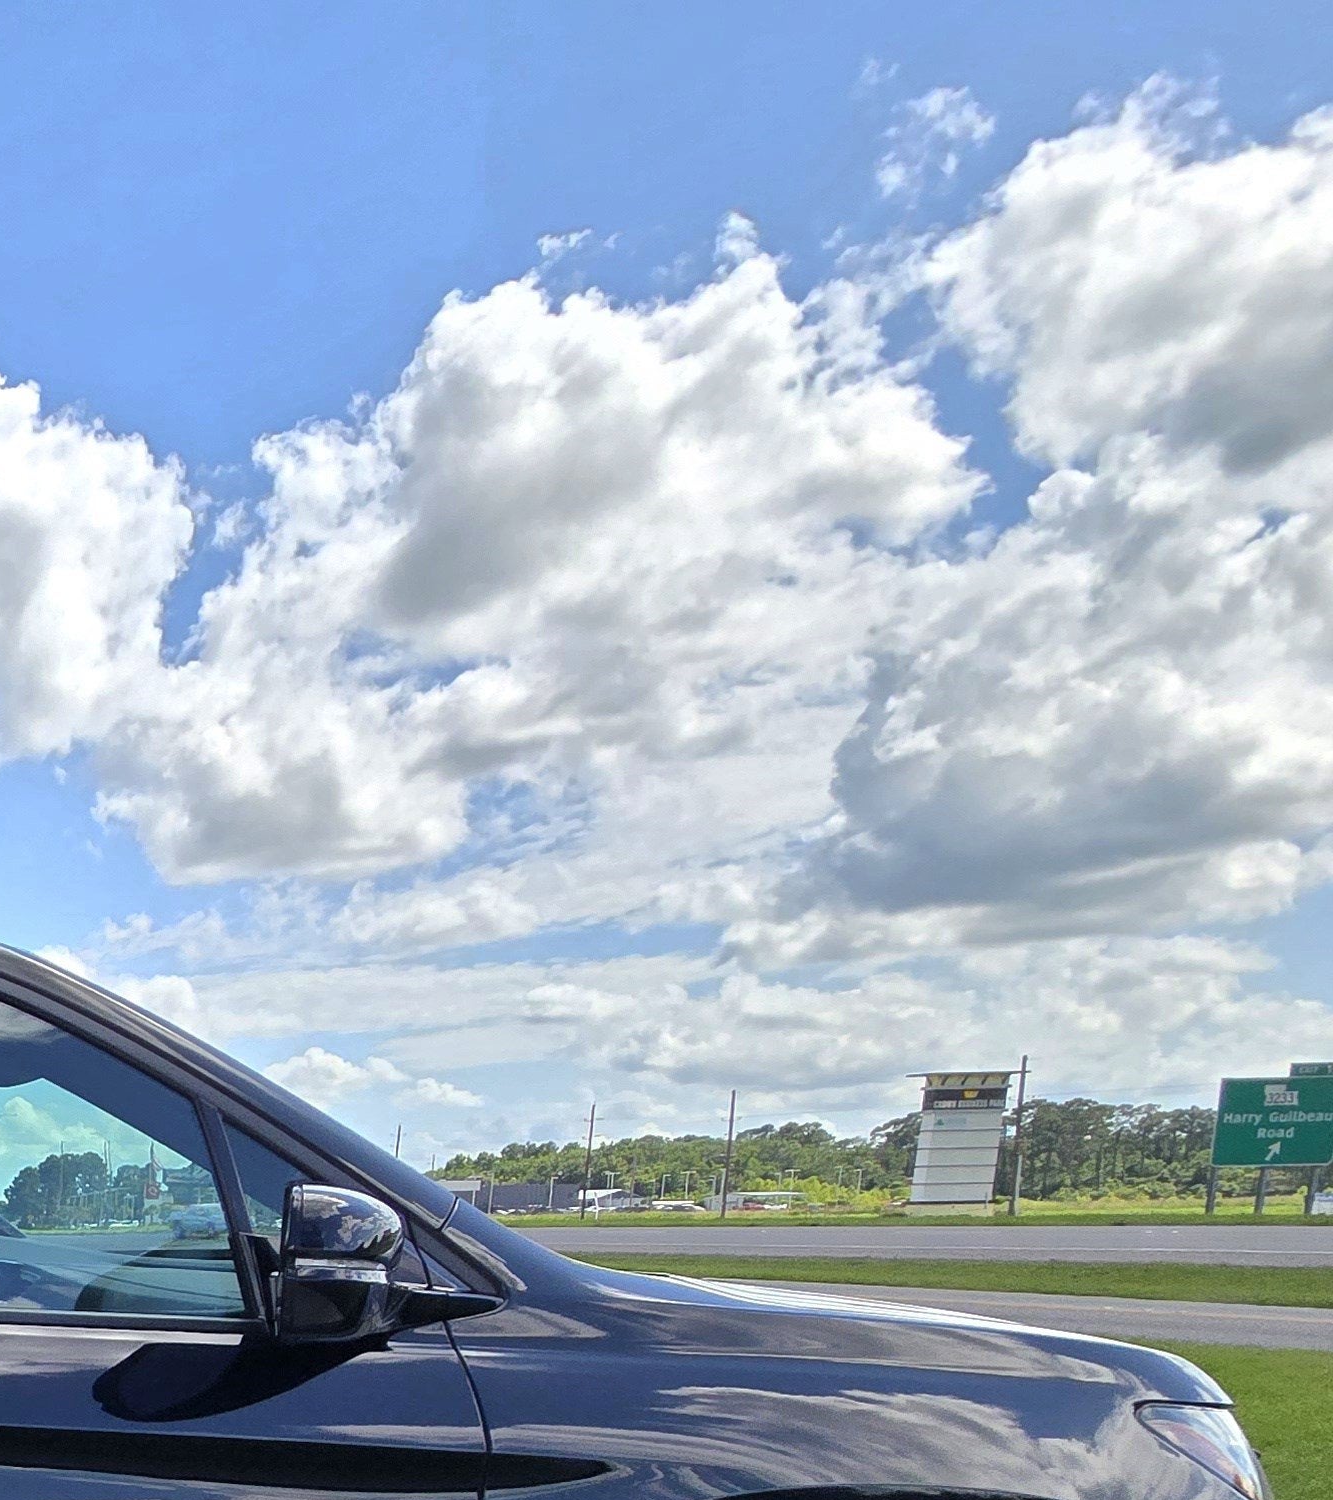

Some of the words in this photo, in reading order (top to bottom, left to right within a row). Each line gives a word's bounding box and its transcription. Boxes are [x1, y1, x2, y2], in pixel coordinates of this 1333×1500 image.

[1266, 1092, 1295, 1104] 3233
[1223, 1113, 1262, 1126] Harry
[1256, 1126, 1295, 1139] Road
